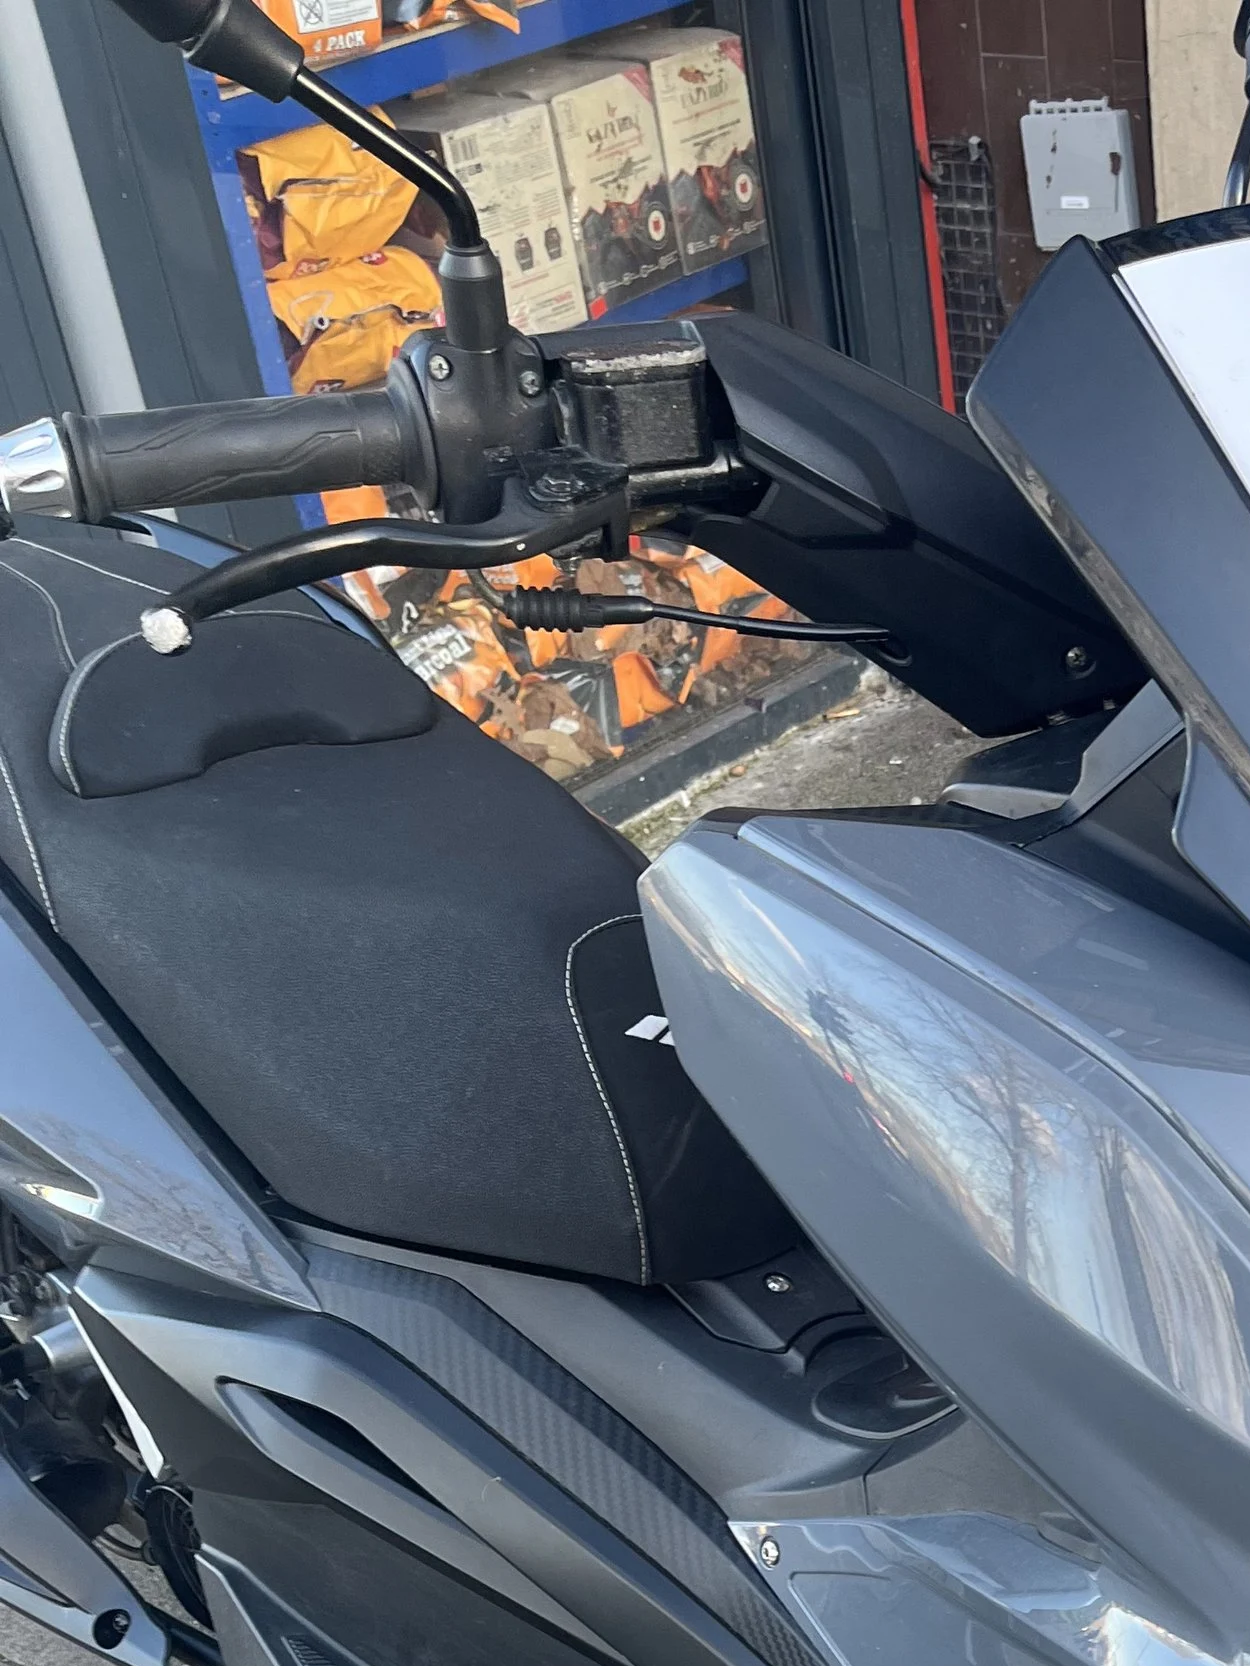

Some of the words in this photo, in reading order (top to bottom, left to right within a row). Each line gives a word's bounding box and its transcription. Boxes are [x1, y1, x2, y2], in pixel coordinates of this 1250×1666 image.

[312, 39, 323, 52] 4
[326, 30, 366, 51] PACK
[416, 633, 472, 682] arcoal
